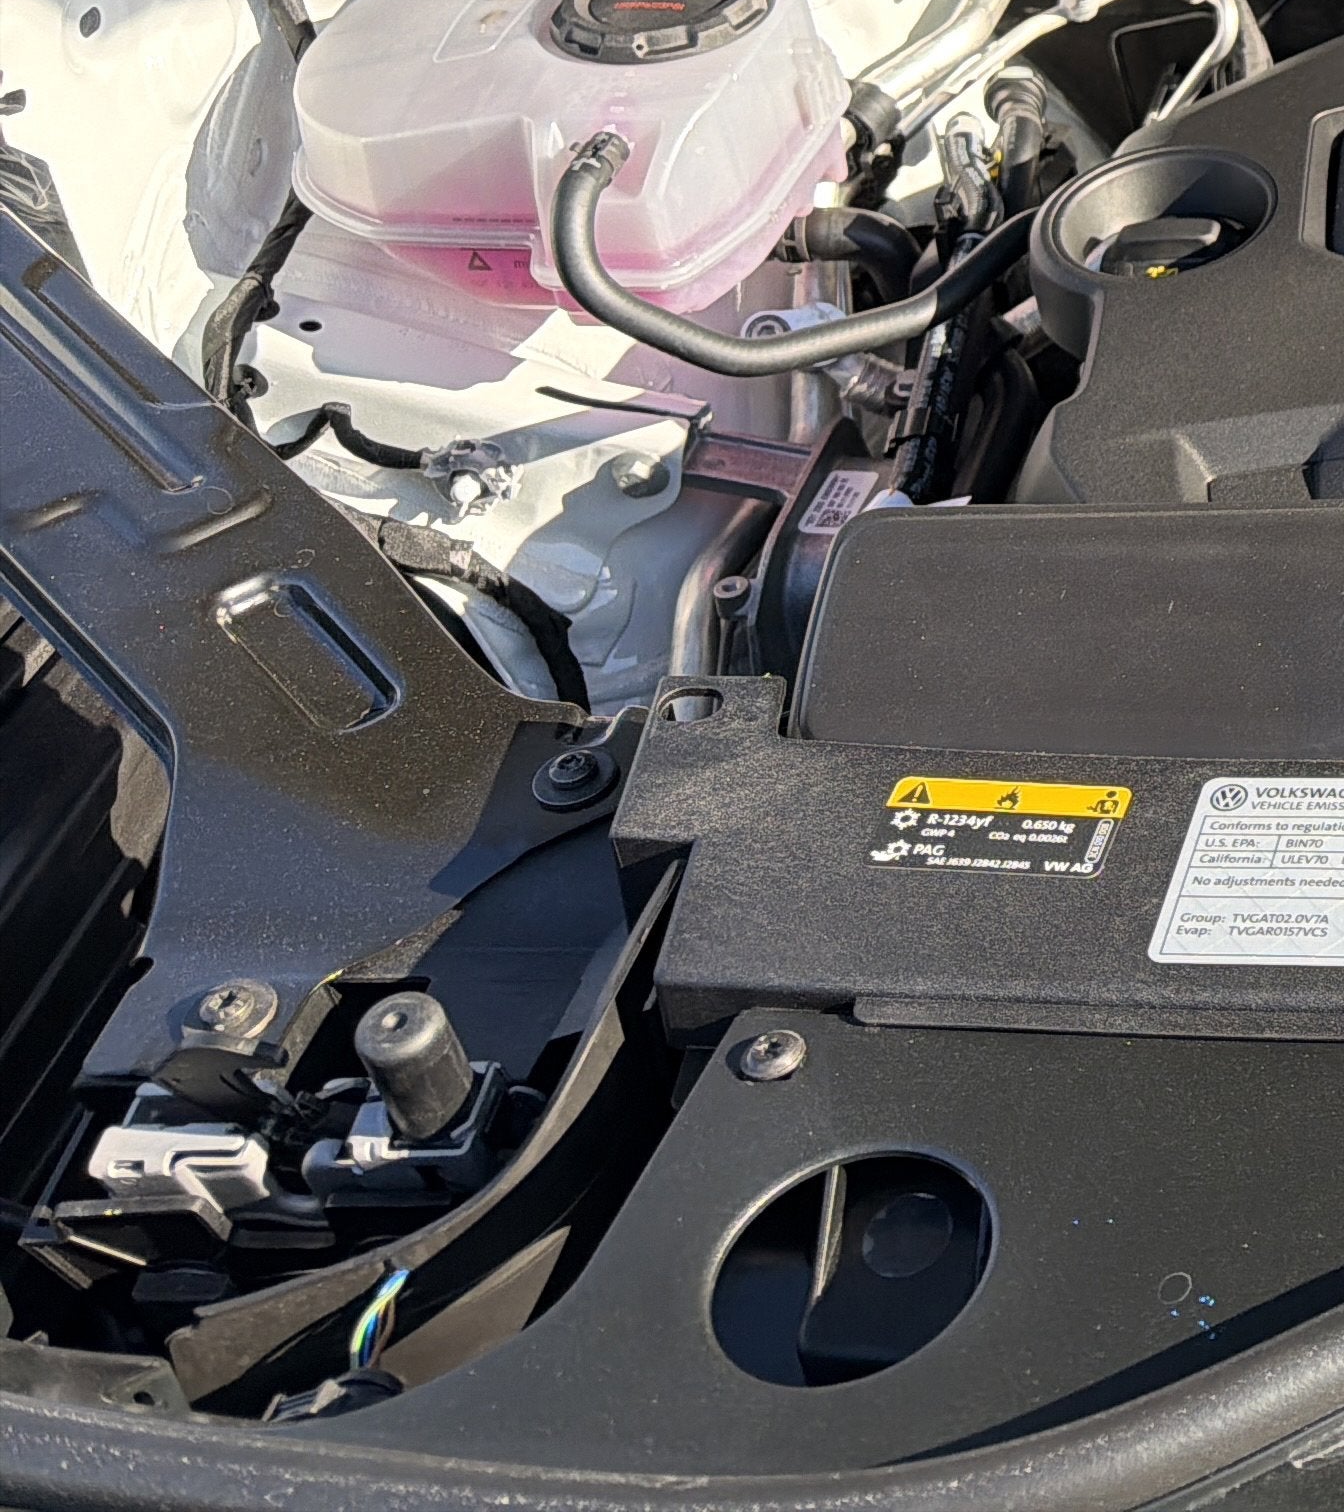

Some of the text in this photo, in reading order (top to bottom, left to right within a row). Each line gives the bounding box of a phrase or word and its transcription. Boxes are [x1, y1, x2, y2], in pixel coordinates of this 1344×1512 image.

[1251, 801, 1302, 811] VEHICLE
[926, 814, 1076, 834] R-1234yf 0.650 kg
[1210, 821, 1273, 832] Conforms
[1276, 822, 1289, 832] to
[921, 828, 956, 837] GWP 4
[1205, 839, 1229, 848] U.S.
[1232, 839, 1261, 848] EPA:
[1286, 839, 1324, 849] BIN70
[913, 844, 945, 856] PAG
[1199, 854, 1267, 864] California:
[1281, 855, 1329, 865] ULEV70
[1044, 861, 1094, 873] VW AG
[1191, 876, 1211, 886] No
[1214, 876, 1296, 888] adjustments
[1180, 913, 1226, 924] Group:
[1176, 926, 1212, 937] Evap:
